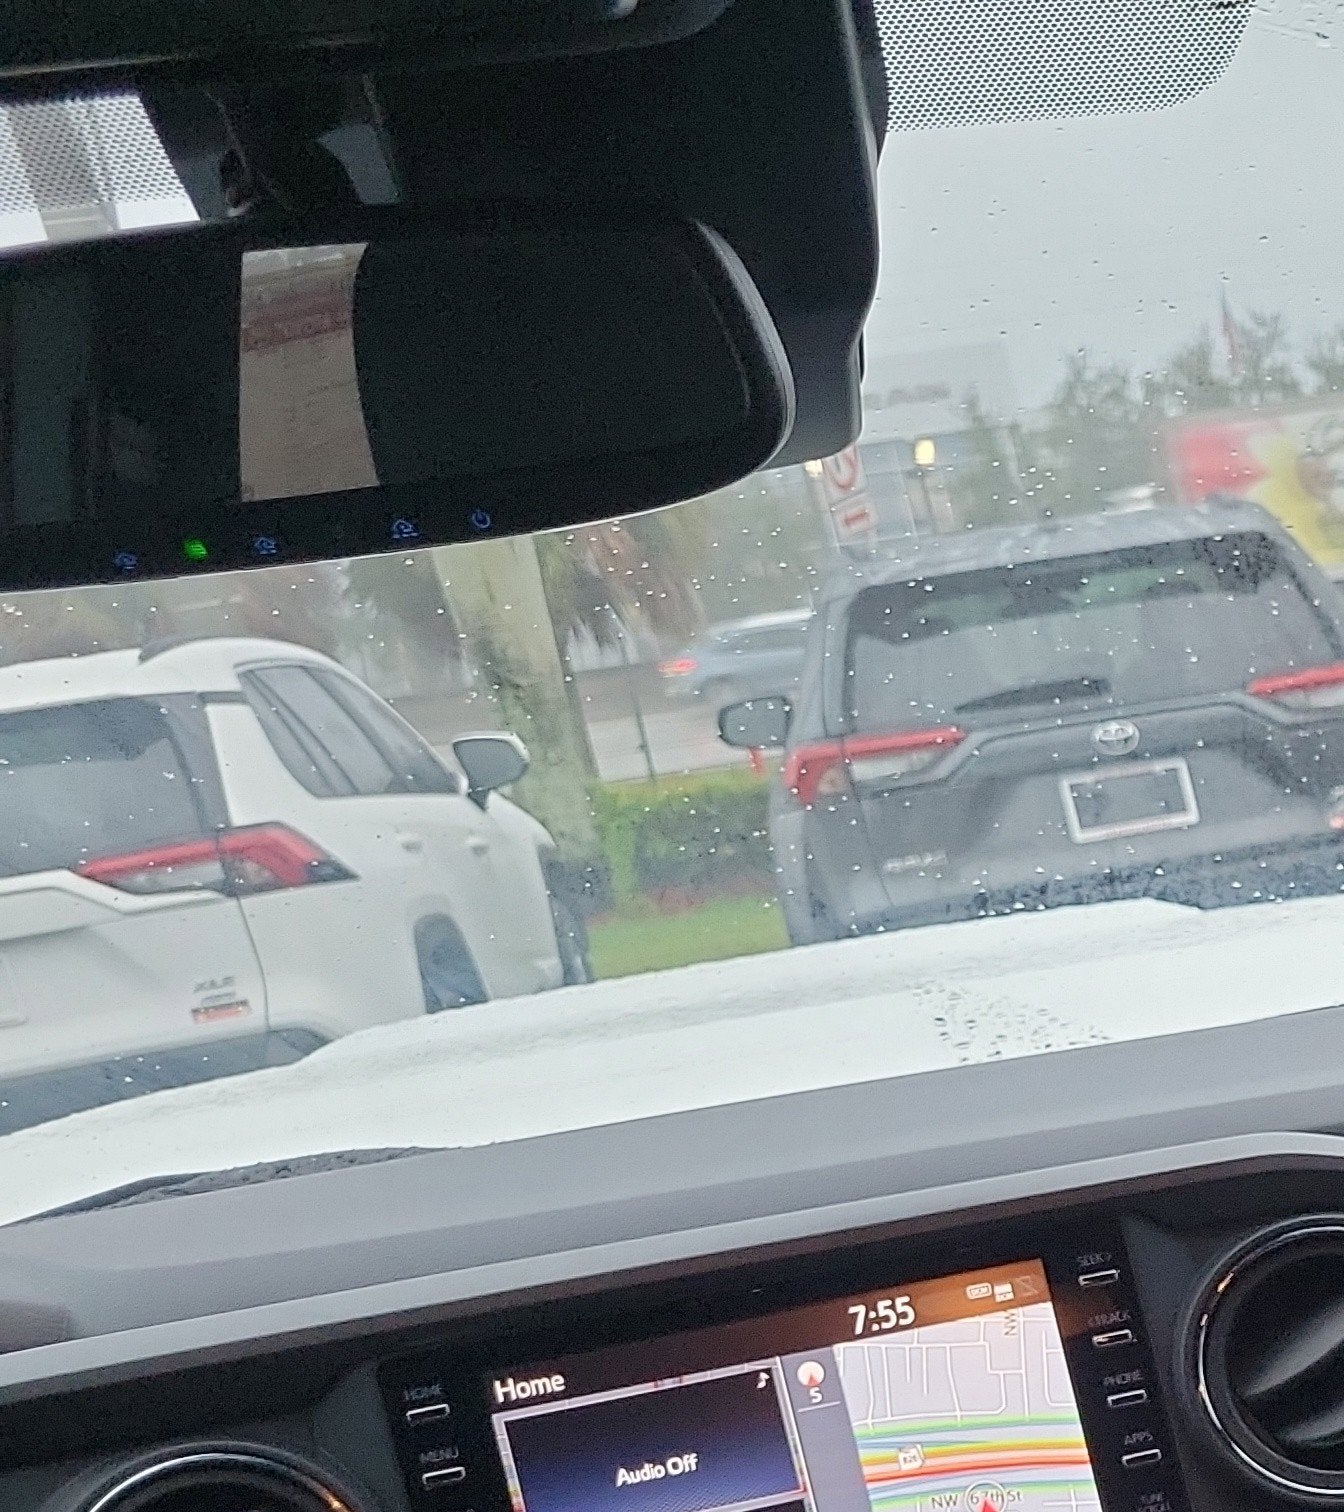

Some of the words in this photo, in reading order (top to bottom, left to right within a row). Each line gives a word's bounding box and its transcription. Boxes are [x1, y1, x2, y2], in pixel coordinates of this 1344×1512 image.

[847, 1295, 916, 1335] 7:55
[494, 1372, 567, 1403] Home
[1105, 1371, 1145, 1387] PHONE
[405, 1385, 443, 1402] HOME
[809, 1389, 823, 1403] S
[1124, 1432, 1154, 1447] APPS
[420, 1447, 460, 1464] MENU
[616, 1462, 664, 1488] Audio
[667, 1452, 698, 1475] Off
[931, 1494, 959, 1510] NW
[970, 1490, 1003, 1506] 67th
[1007, 1489, 1022, 1502] St
